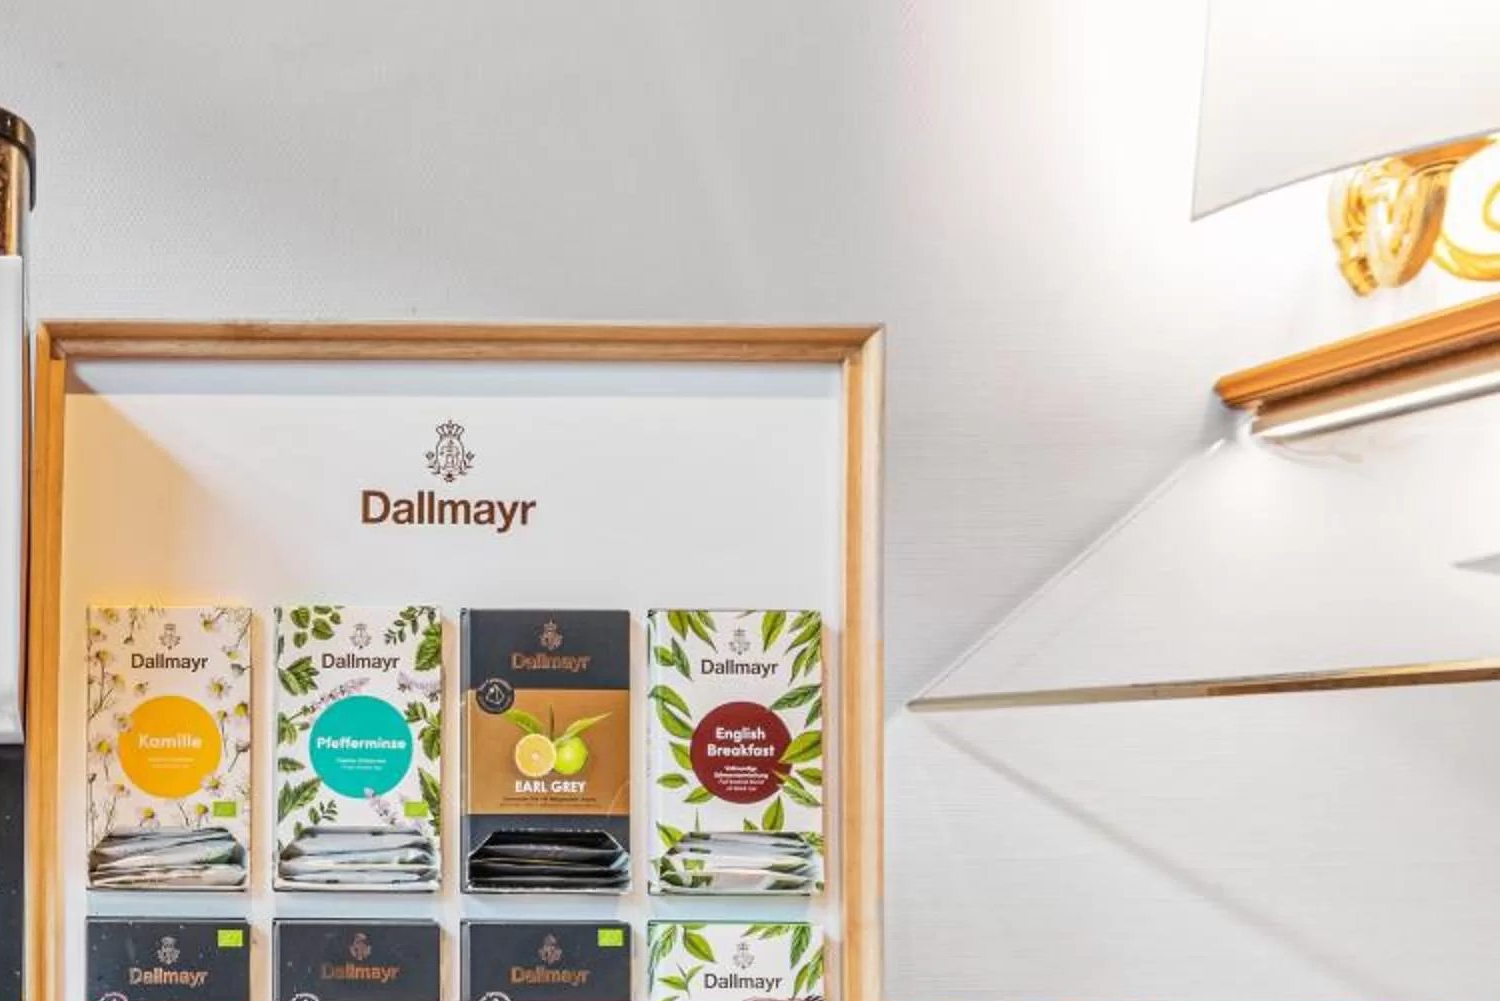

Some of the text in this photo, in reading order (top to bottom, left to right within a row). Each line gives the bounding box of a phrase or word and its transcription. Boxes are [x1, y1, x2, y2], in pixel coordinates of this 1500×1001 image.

[361, 490, 537, 533] Dallmayr
[131, 652, 209, 672] Dallmayr
[321, 652, 400, 672] Dallmayr
[511, 652, 591, 673] Dallmayr
[701, 658, 779, 677] Dallmayr
[138, 732, 202, 749] Kamille
[316, 736, 407, 750] Pfefferminze
[715, 726, 766, 743] English
[707, 743, 775, 757] Breakfast
[515, 780, 586, 793] EARL GREY
[129, 967, 208, 987] Dallmayr
[321, 962, 400, 982] Dallmayr
[511, 965, 591, 985] Dallmayr
[704, 972, 783, 992] Dallmayr
